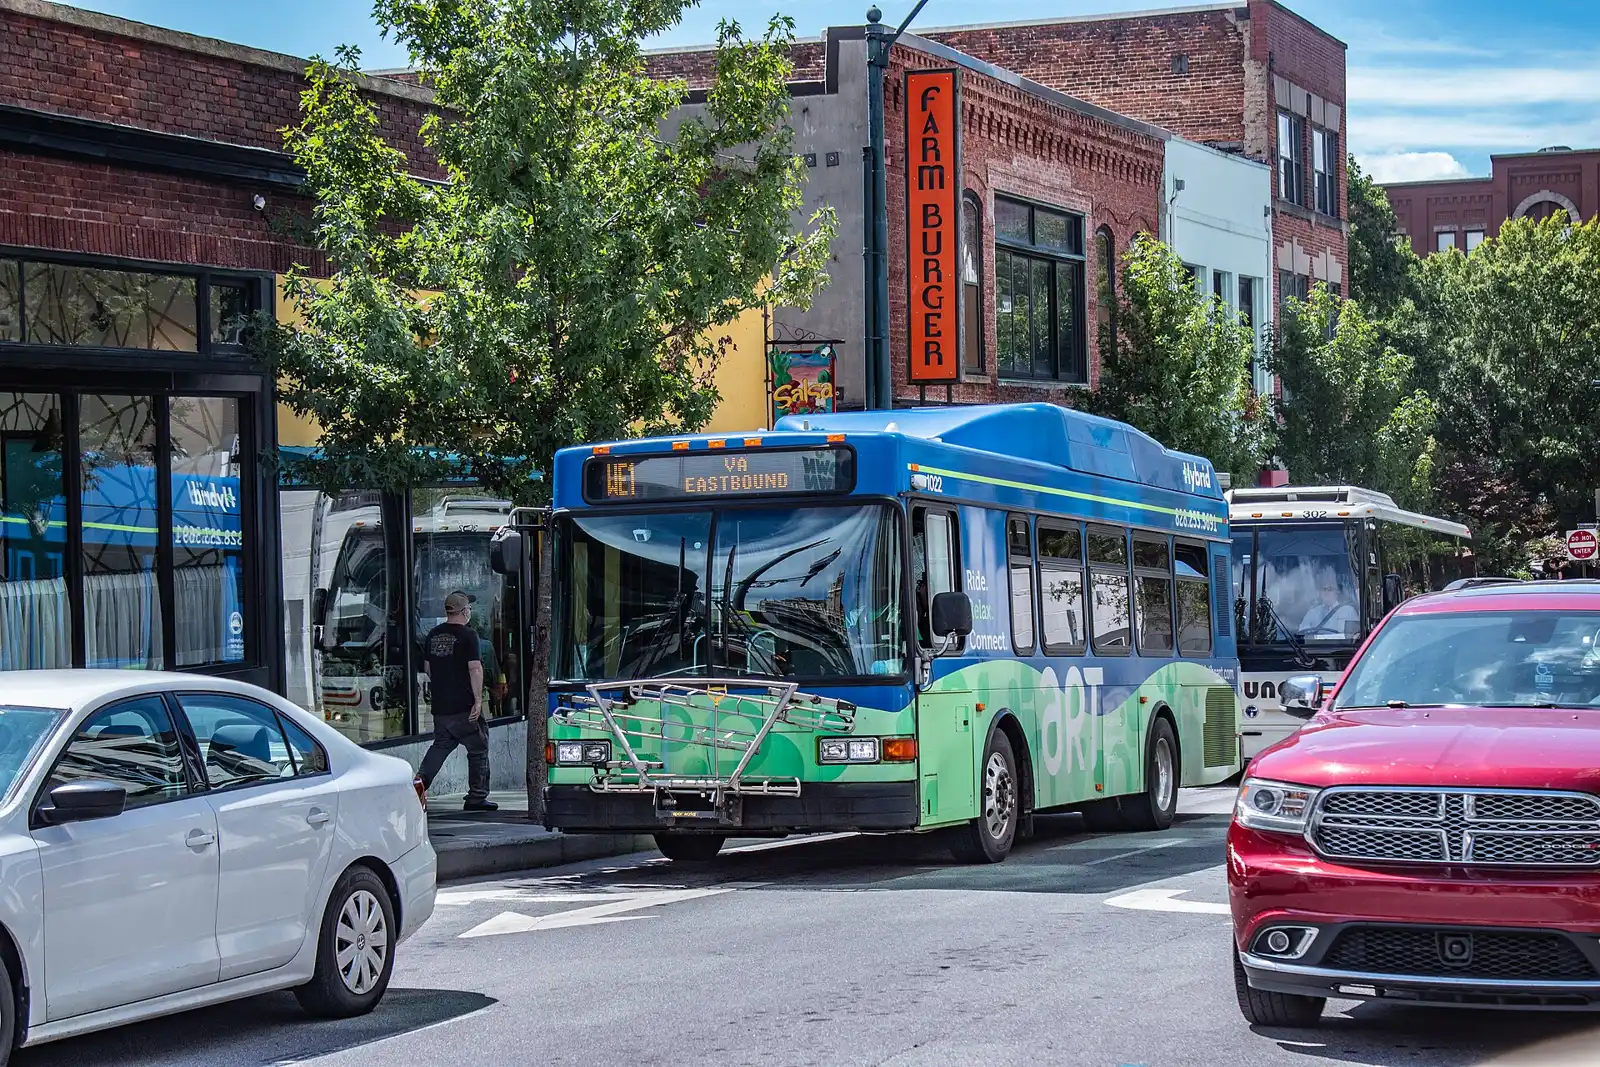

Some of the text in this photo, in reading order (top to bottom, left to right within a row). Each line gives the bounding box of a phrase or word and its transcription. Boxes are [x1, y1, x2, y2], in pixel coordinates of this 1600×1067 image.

[917, 86, 945, 366] FARM BURGER
[773, 376, 833, 409] Salsa
[724, 457, 748, 472] VA
[606, 462, 635, 496] WE1
[685, 473, 788, 493] EASTBOUND
[926, 474, 942, 492] 1022
[1183, 462, 1211, 492] Hybrid
[1302, 510, 1327, 518] 302
[966, 569, 989, 591] Ride.
[969, 629, 1009, 650] Connect.
